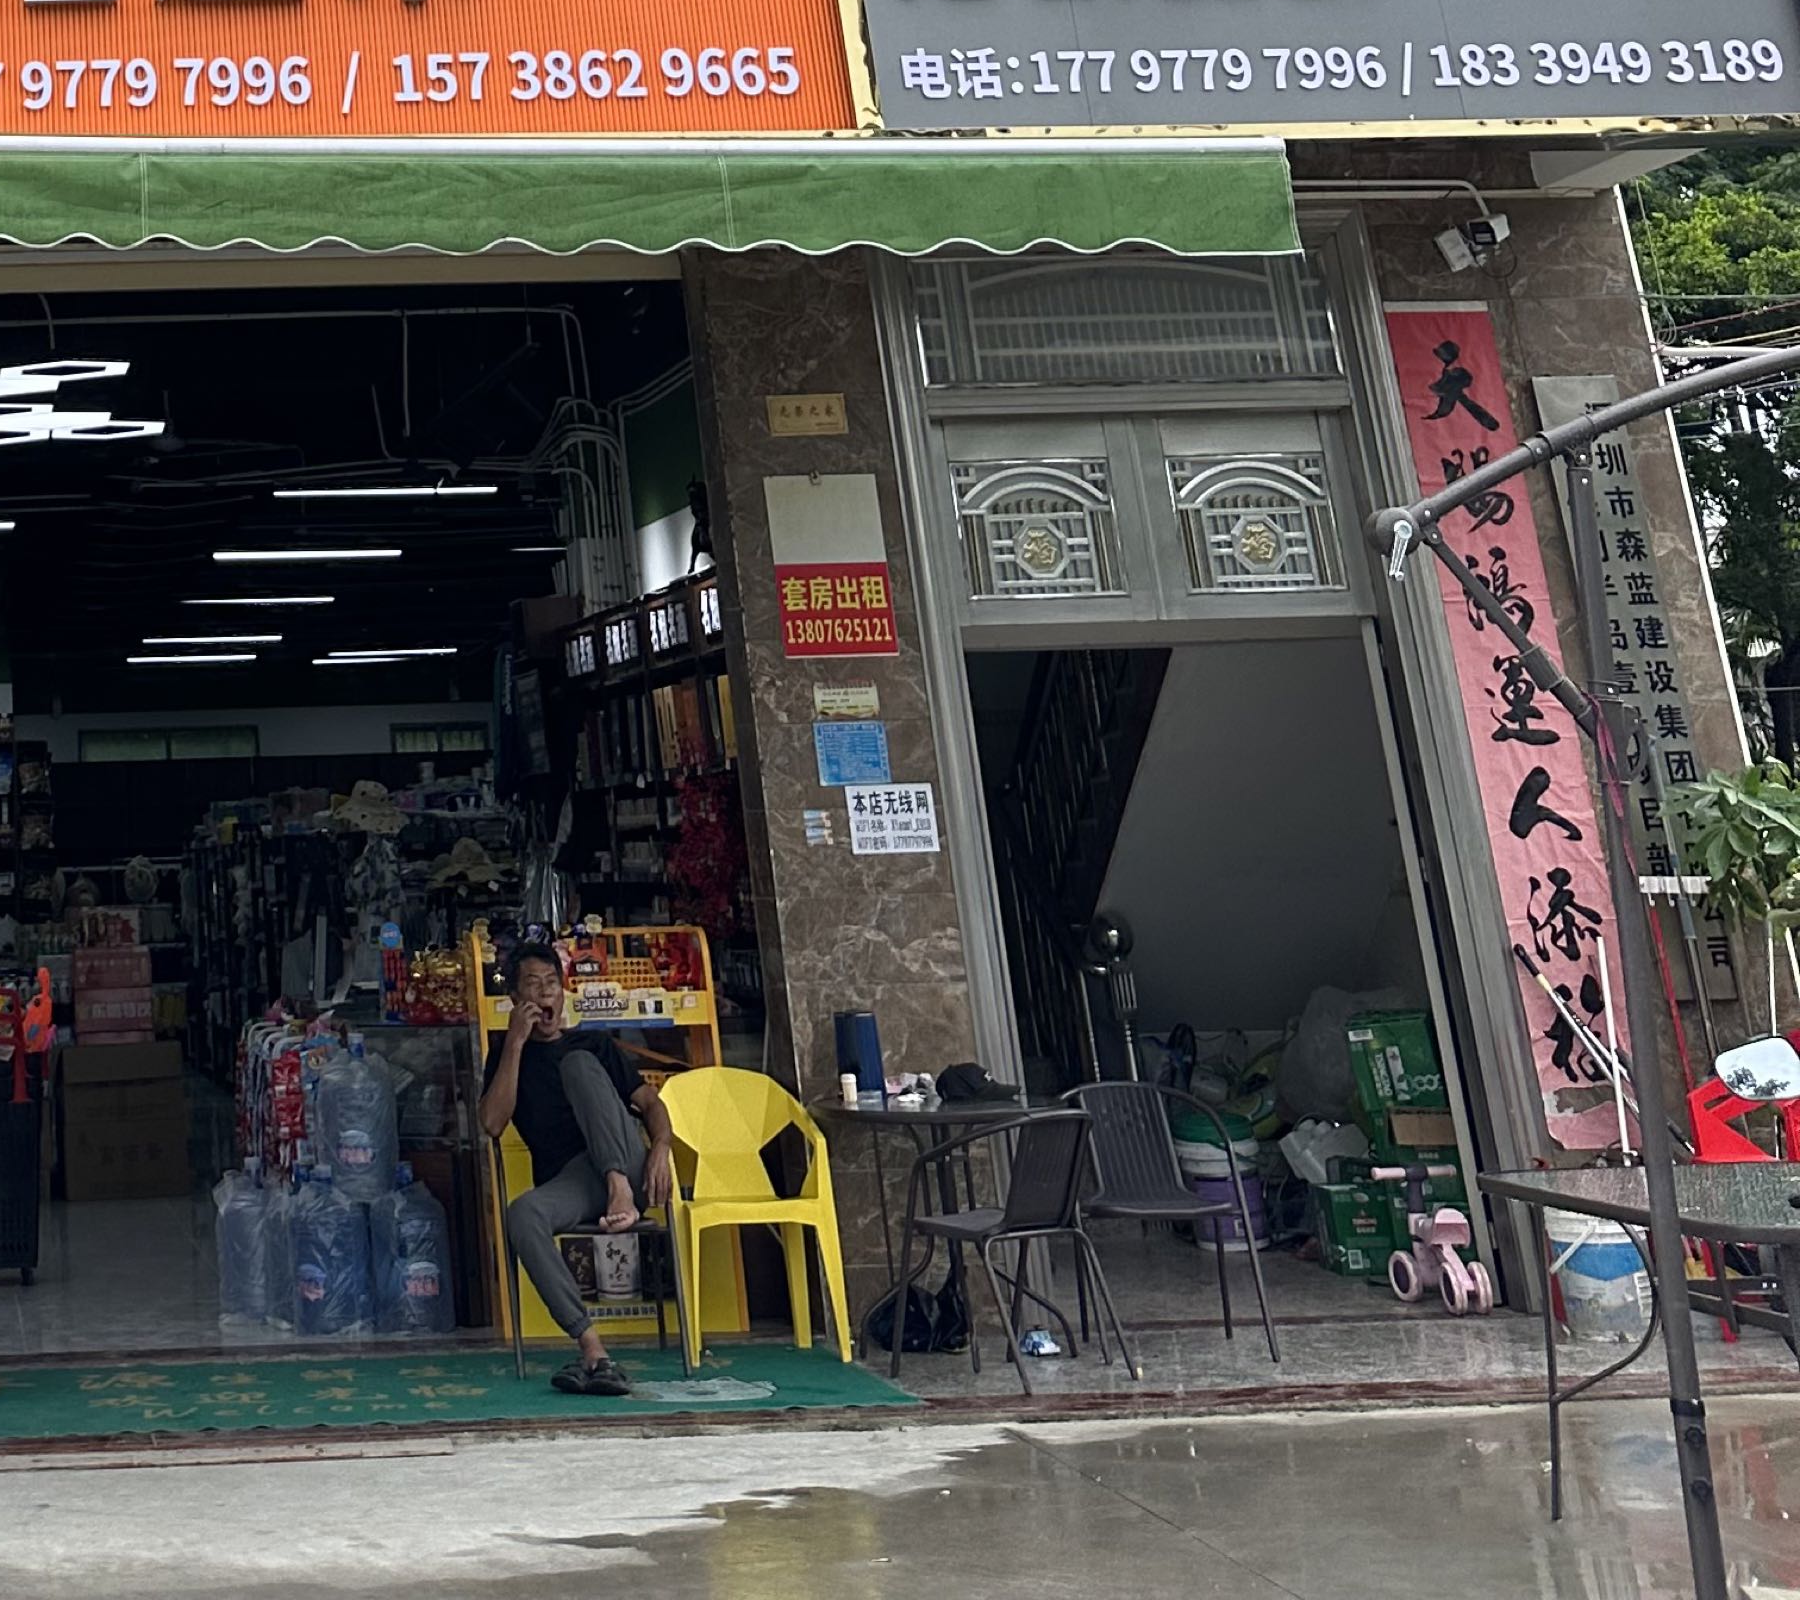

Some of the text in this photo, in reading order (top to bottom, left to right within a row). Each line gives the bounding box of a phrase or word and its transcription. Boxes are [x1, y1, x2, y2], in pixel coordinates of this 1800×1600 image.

[21, 57, 157, 111] 9779
[174, 55, 312, 106] 7996
[392, 52, 490, 102] 157
[508, 48, 648, 100] 3862
[660, 46, 801, 97] 9665
[1132, 45, 1252, 94] 9779
[1263, 44, 1386, 90] 7996
[1430, 42, 1520, 88] 183
[1530, 40, 1652, 84] 3949
[1662, 38, 1784, 82] 3189
[782, 575, 889, 612] 套房出租
[786, 617, 893, 645] 13807625121
[852, 790, 930, 816] 本店无线网
